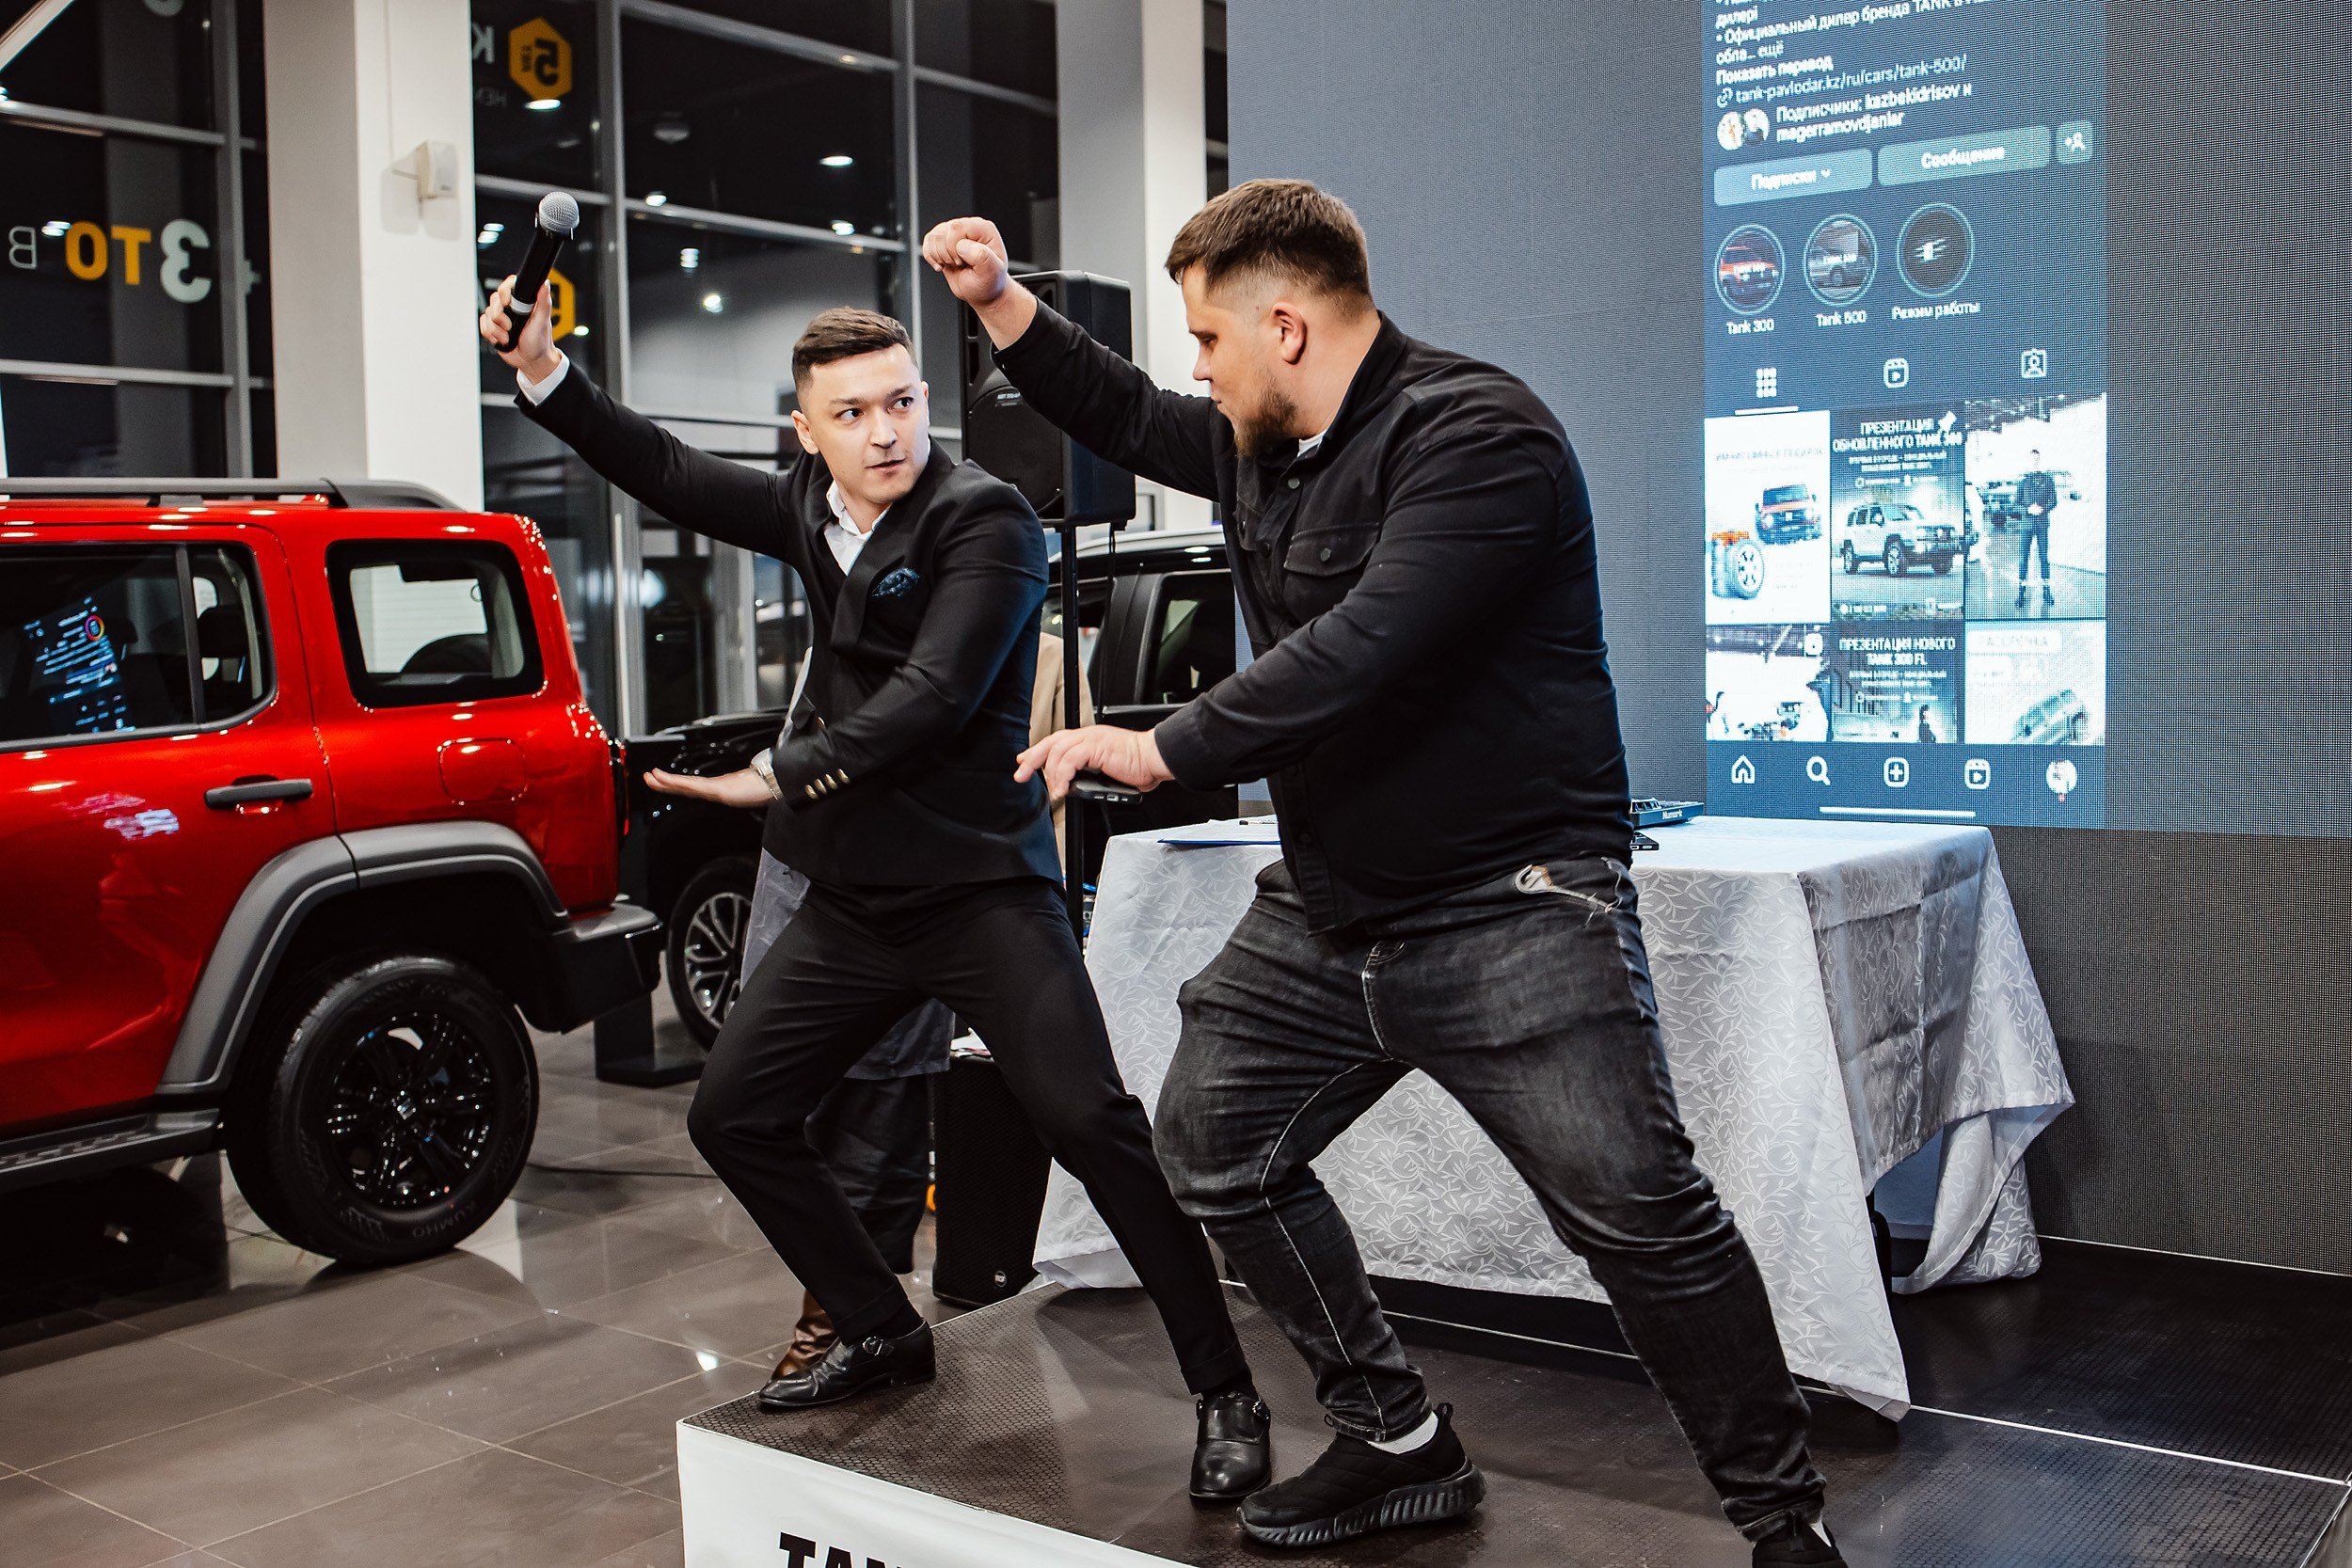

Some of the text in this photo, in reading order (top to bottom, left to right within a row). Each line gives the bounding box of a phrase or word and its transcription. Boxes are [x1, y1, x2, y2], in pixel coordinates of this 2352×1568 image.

[1724, 14, 1818, 45] Официальный
[1818, 10, 1860, 30] дилер
[1862, 3, 1909, 24] бренда
[1757, 40, 1784, 58] ещё
[1716, 55, 1835, 86] Показать перевод
[1736, 54, 1967, 103] tank-pavlodar.kz/ru/cars/tank-500/
[1776, 98, 1863, 123] Подписчики:
[1963, 83, 1972, 96] и
[1921, 146, 2005, 168] Сообщение
[1751, 169, 1817, 190] Подписки
[1816, 312, 1842, 327] Tank
[1891, 300, 1981, 320] Режим работы
[1725, 318, 1775, 335] Tank 300
[1860, 418, 1934, 435] ПРЕЗЕНТАЦИЯ
[1838, 637, 1956, 652] ПРЕЗЕНТАЦИЯ НОВОГО
[1661, 809, 1683, 820] Numark
